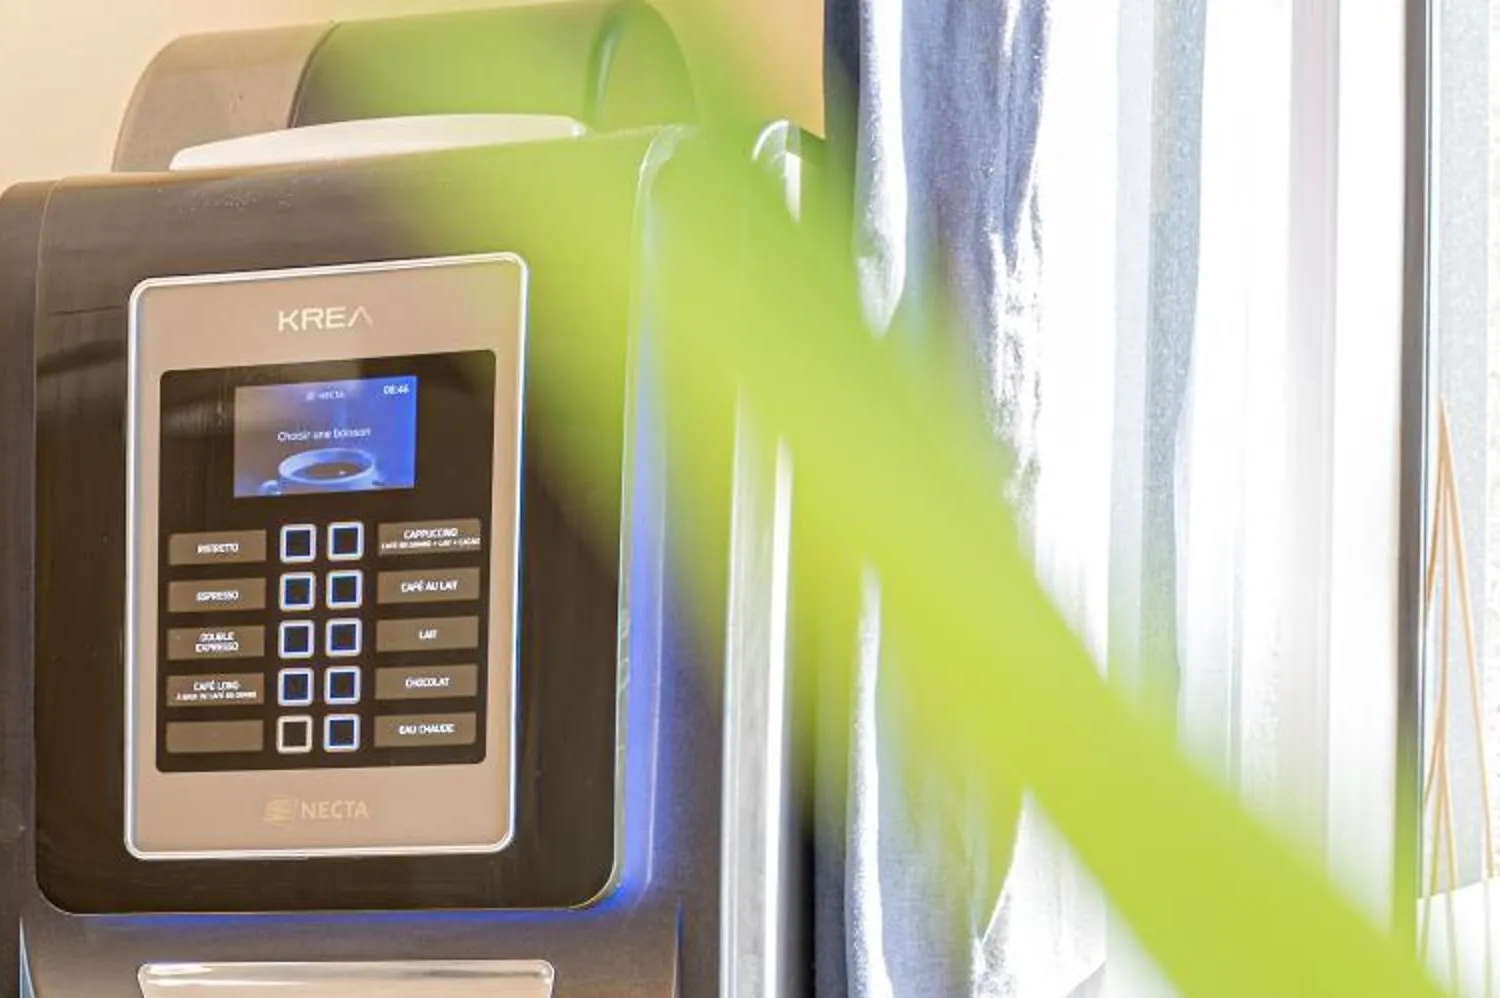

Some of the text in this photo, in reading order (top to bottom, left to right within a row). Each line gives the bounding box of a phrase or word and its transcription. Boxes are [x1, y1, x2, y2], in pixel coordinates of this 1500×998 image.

[278, 305, 374, 332] KREA
[313, 430, 332, 440] une
[333, 427, 371, 439] boisson
[403, 527, 459, 540] CAPPUCCINO
[401, 579, 458, 593] CAFÉ AU LAIT
[419, 629, 437, 640] LAIT
[405, 677, 450, 689] CHOCOLAT
[301, 799, 370, 819] NECTA
